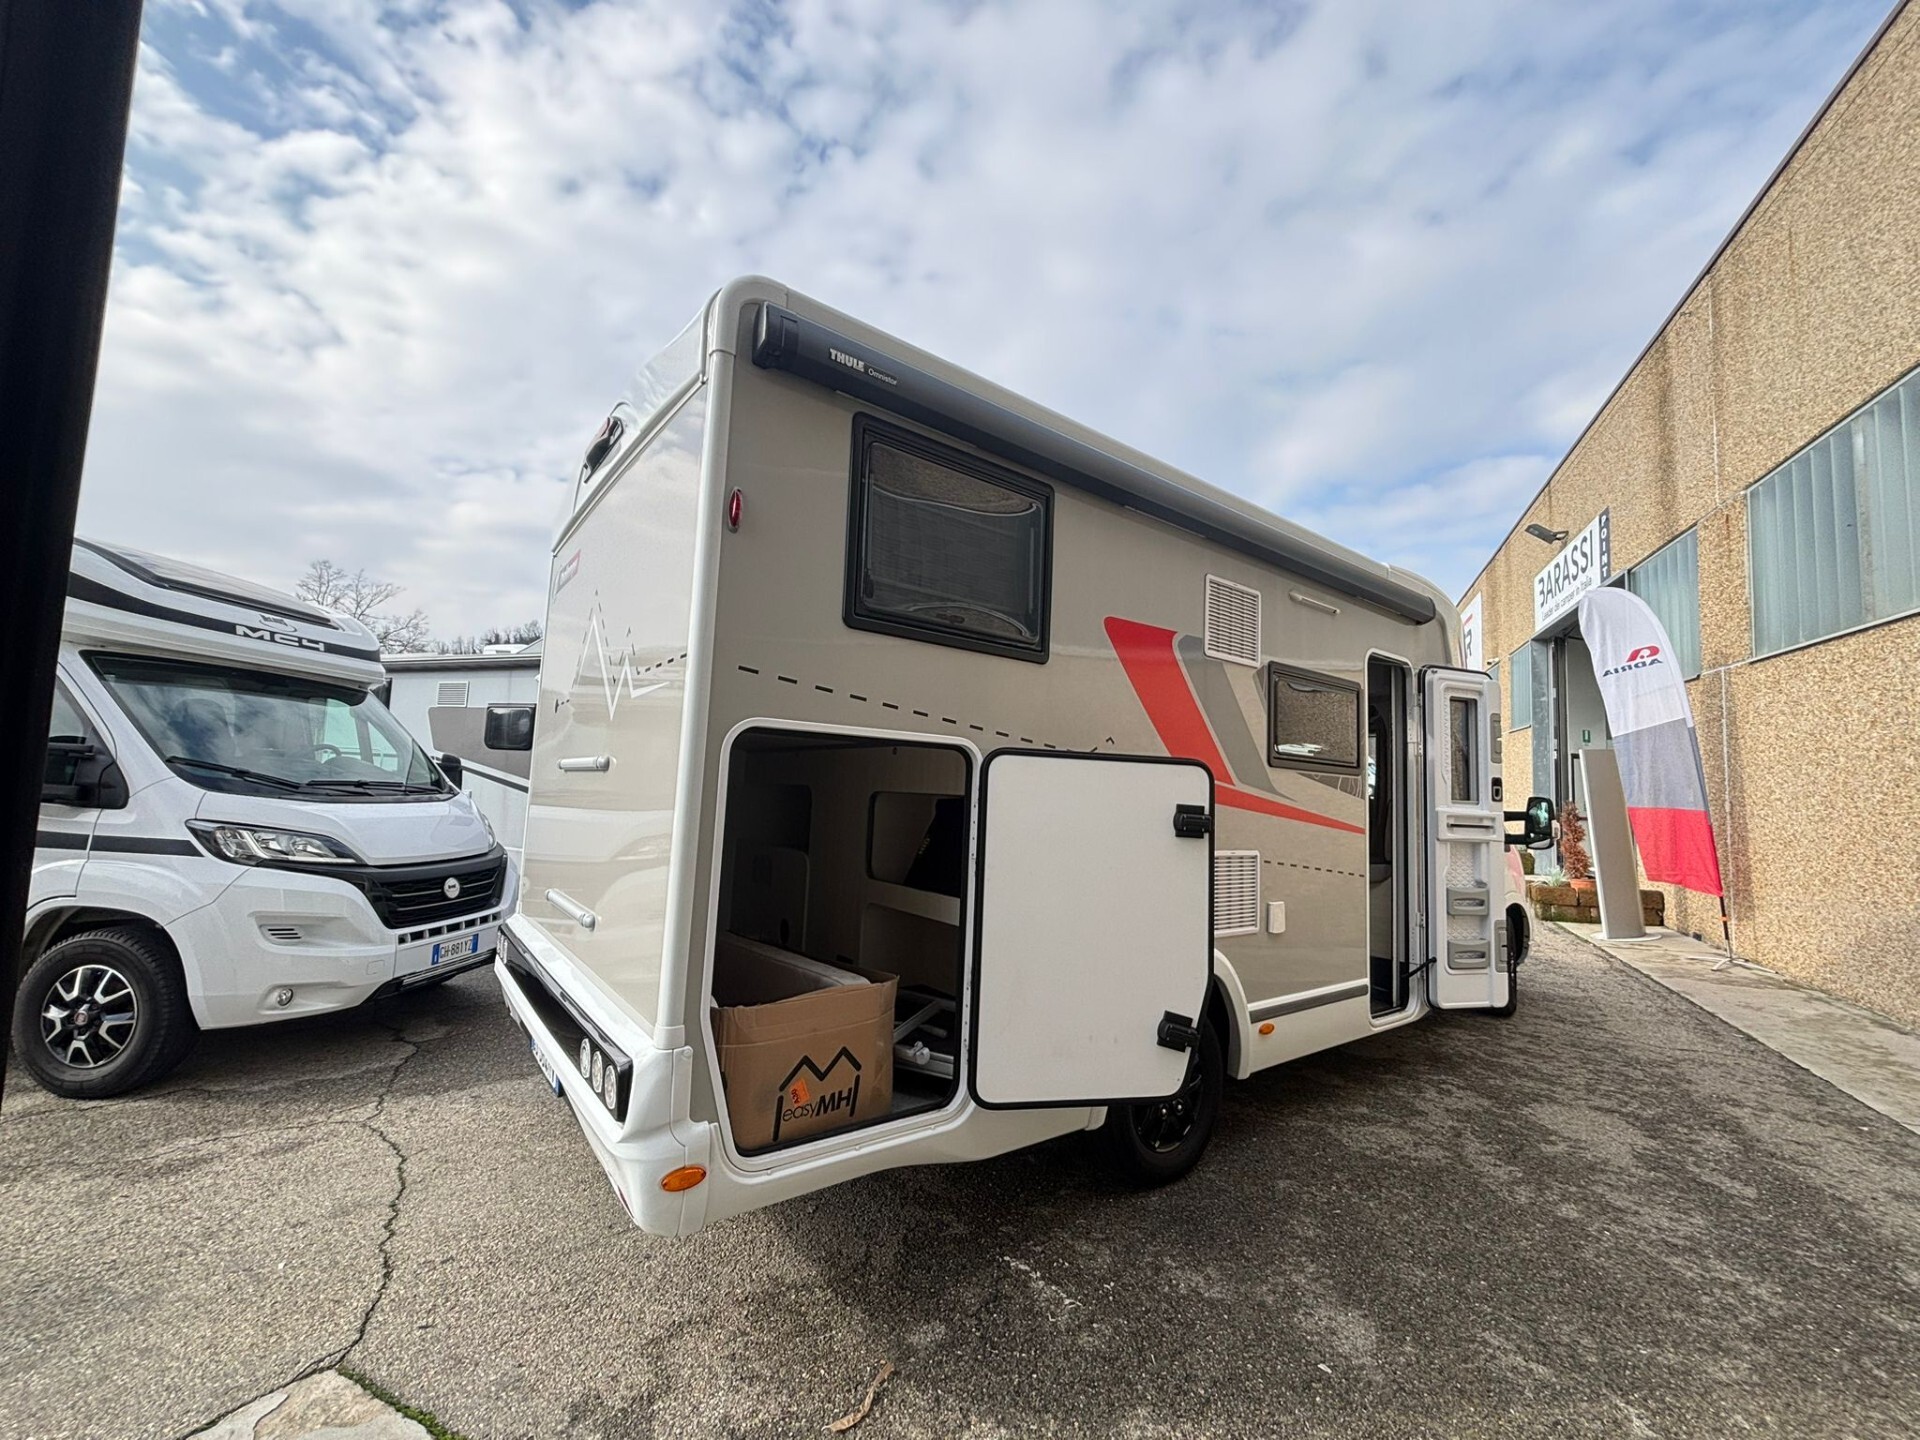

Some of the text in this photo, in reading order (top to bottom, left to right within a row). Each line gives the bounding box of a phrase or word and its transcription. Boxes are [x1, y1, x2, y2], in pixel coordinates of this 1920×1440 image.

[829, 347, 898, 386] THULE Omnistor
[1600, 514, 1608, 578] POINT
[1538, 529, 1594, 608] BARASSI
[235, 624, 325, 652] MC4
[782, 1086, 853, 1122] easyMH
